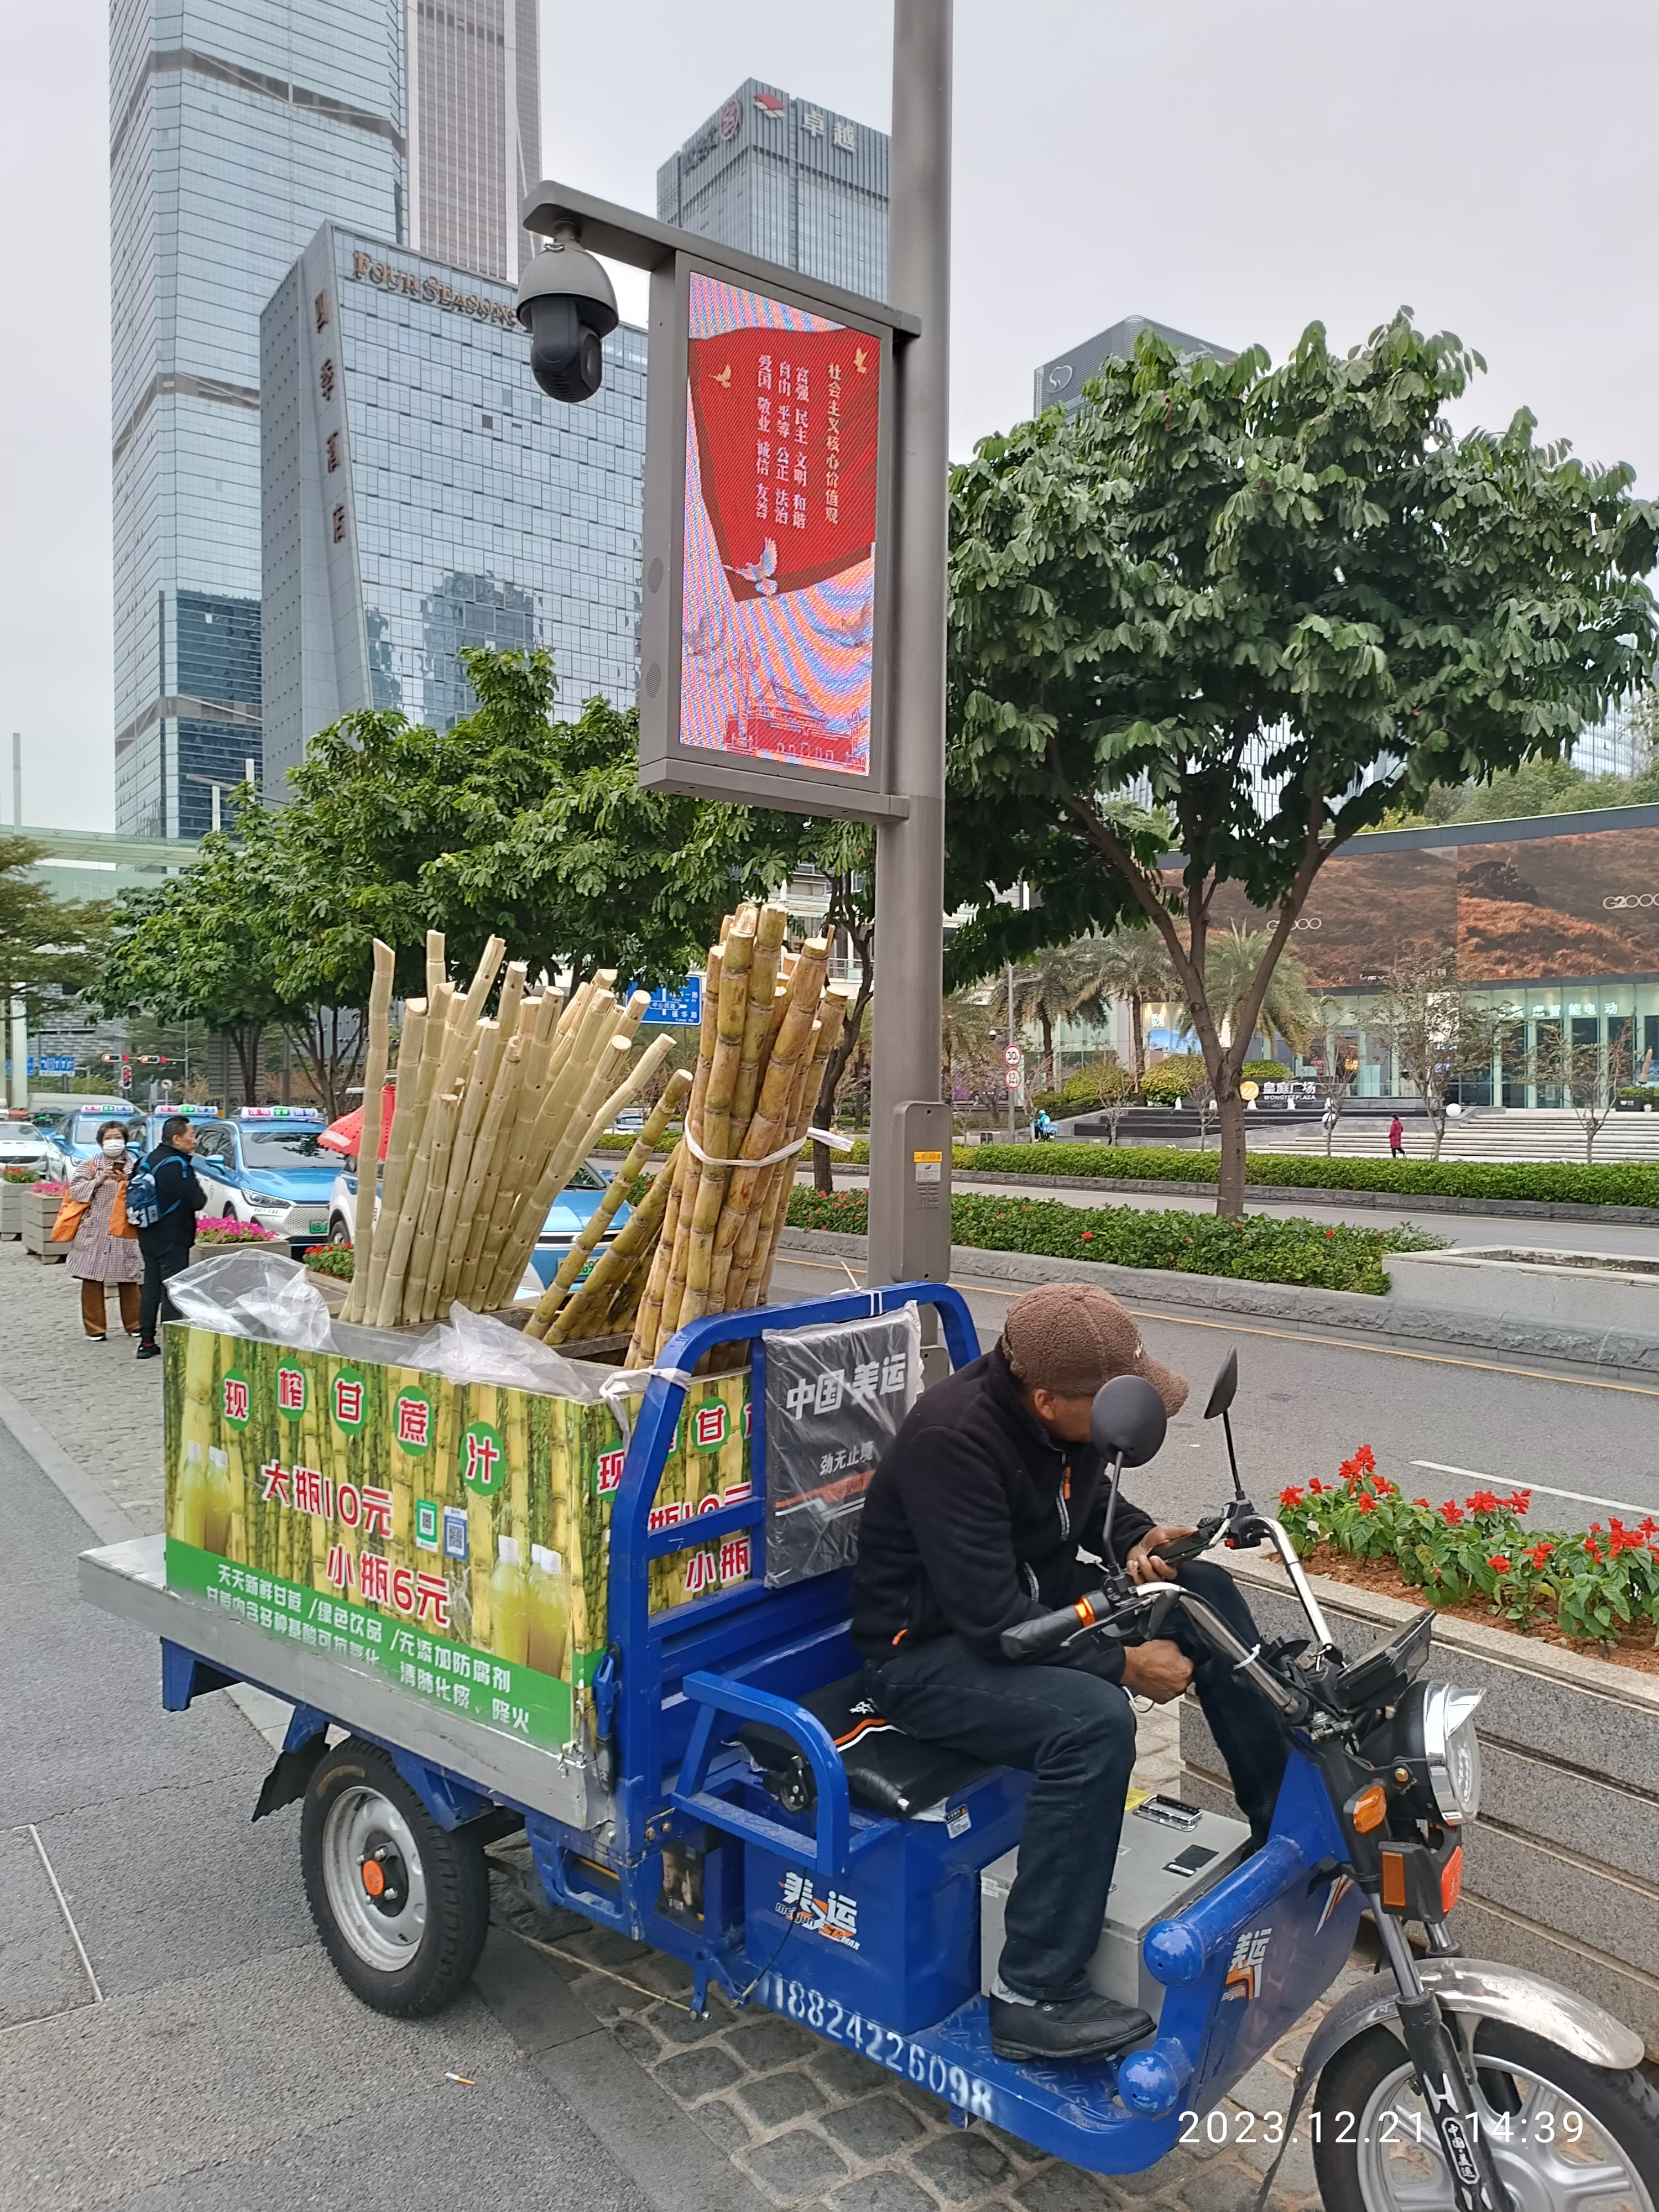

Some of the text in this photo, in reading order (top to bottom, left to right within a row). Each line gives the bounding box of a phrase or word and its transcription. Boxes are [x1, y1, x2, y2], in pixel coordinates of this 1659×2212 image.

[802, 109, 857, 153] 卓越
[353, 250, 419, 295] FOUR
[757, 354, 772, 390] 爱国
[778, 362, 791, 397] 自由
[776, 405, 791, 438] 平等
[795, 408, 809, 445] 民主
[825, 363, 842, 524] 社会主义核心价值观
[775, 447, 790, 482] 公正
[794, 452, 807, 487] 文明
[1266, 918, 1322, 931] G00
[1262, 1081, 1316, 1094] 皇庭广场
[223, 1366, 500, 1485] 现榨甘蔗汁
[260, 1459, 395, 1540] 大瓶10元
[326, 1543, 452, 1629] 小瓶6元
[782, 1871, 857, 1934] 美运
[774, 1973, 993, 2117] 18824226098
